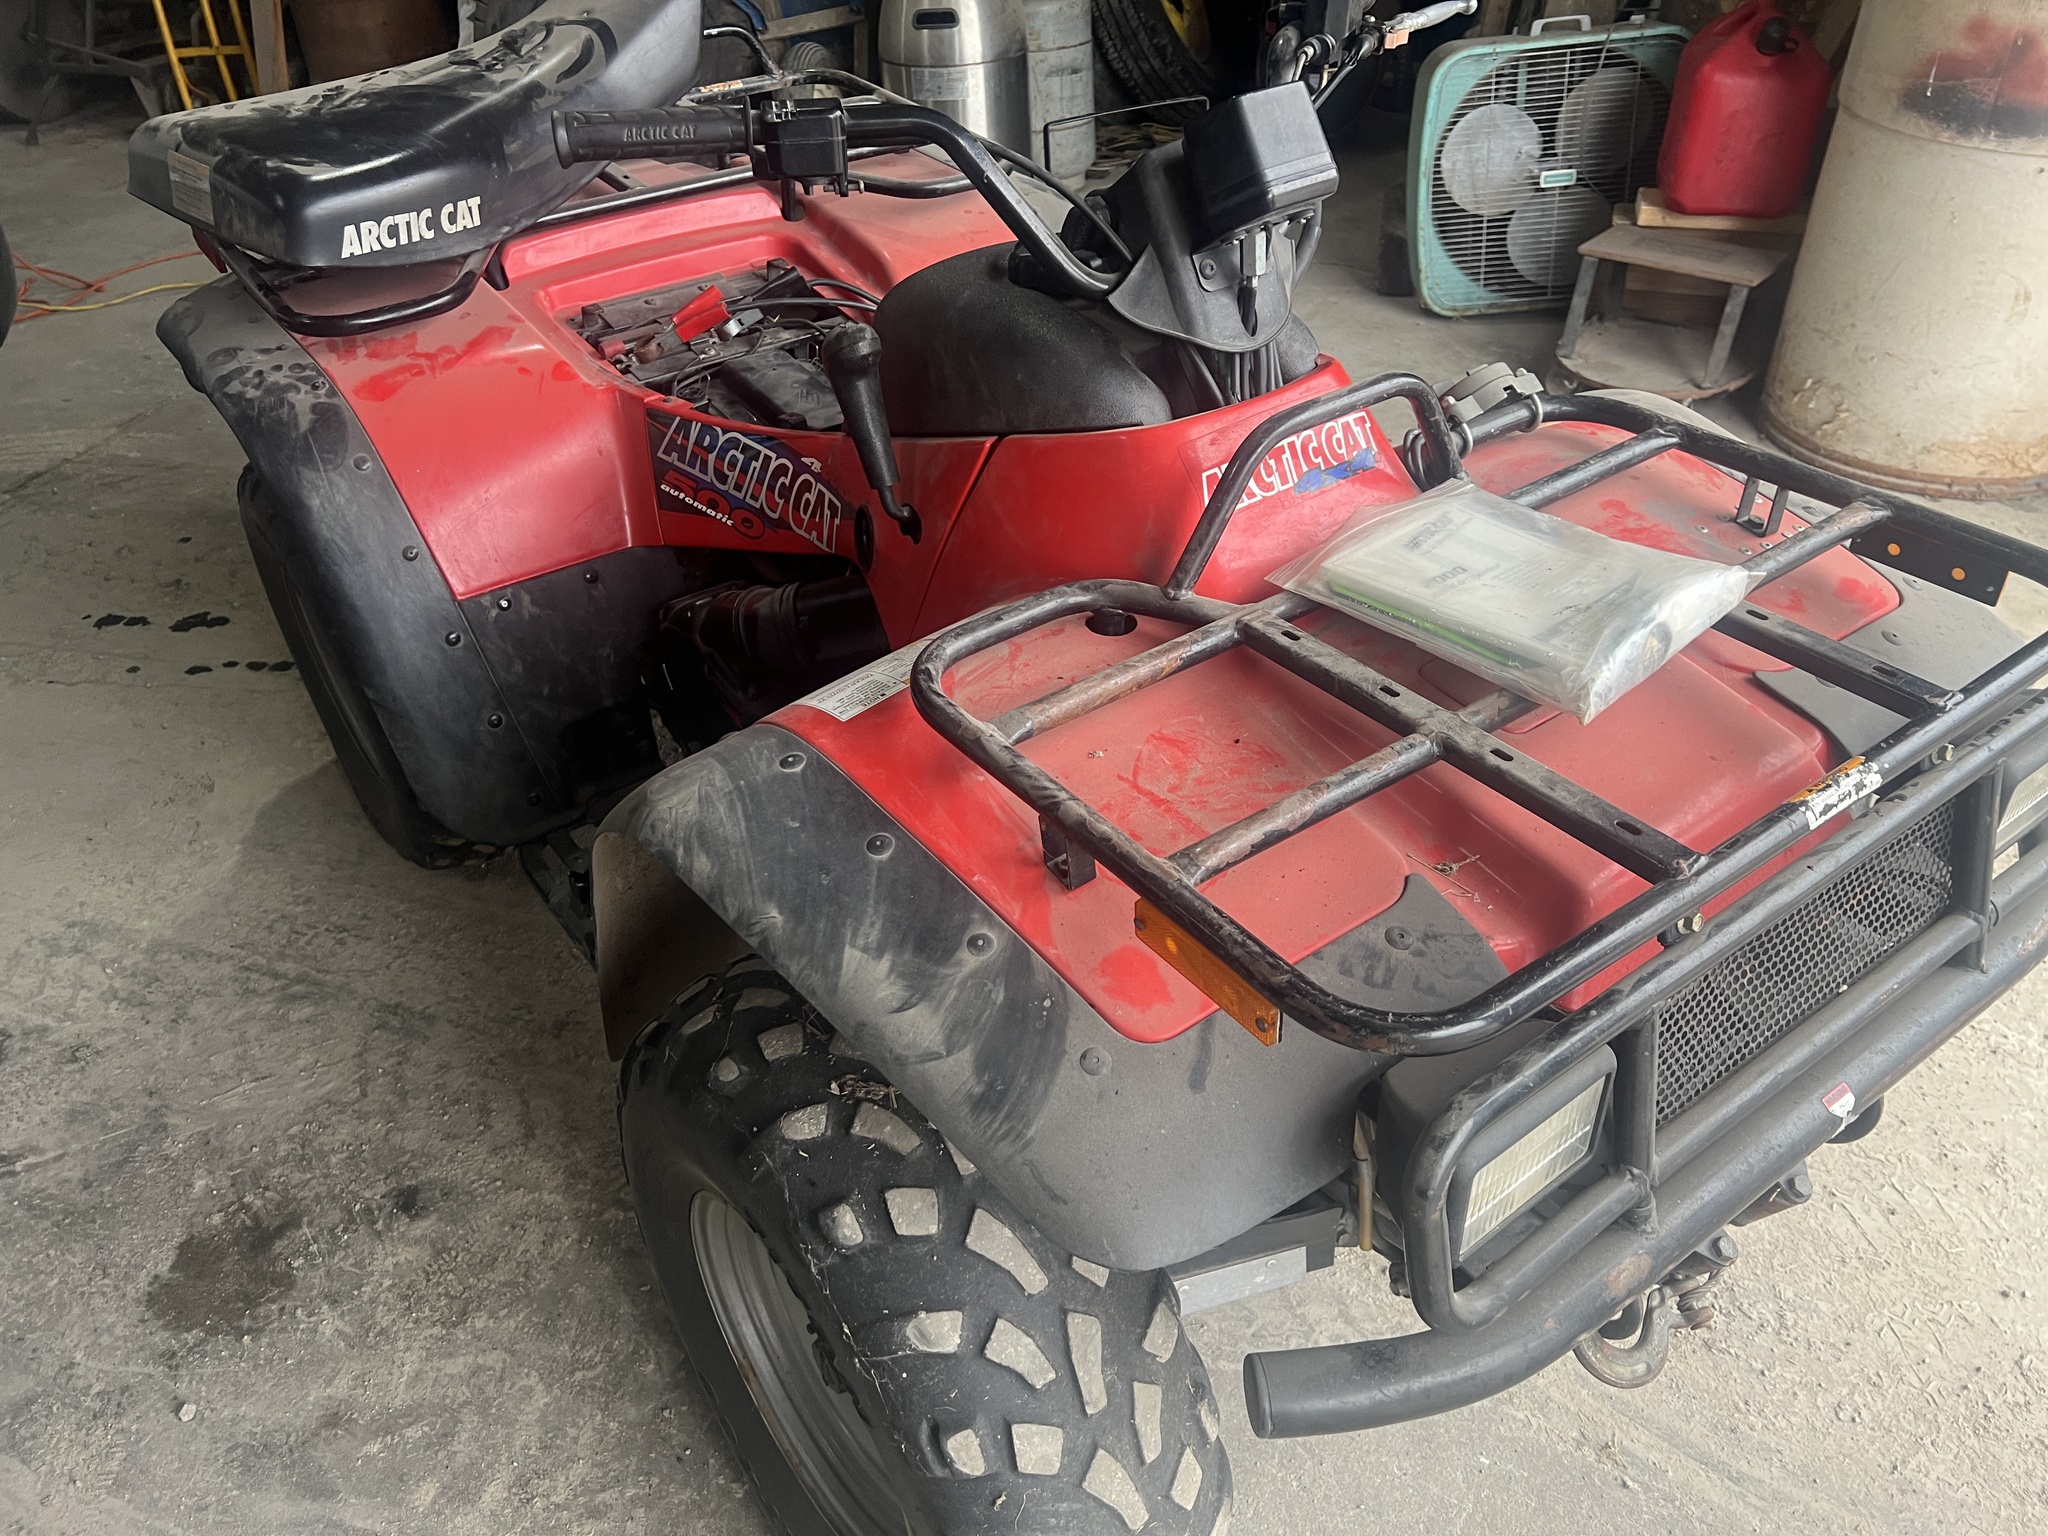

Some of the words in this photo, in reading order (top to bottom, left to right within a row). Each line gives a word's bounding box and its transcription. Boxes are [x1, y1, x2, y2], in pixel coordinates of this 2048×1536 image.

[623, 126, 668, 141] ARCTIC
[672, 124, 697, 138] CAT
[341, 208, 435, 259] ARCTIC
[440, 196, 481, 234] CAT
[1321, 411, 1378, 467] CAT
[657, 416, 794, 519] ARCTIC
[789, 474, 842, 554] CAT
[660, 483, 735, 527] automatic
[661, 469, 766, 540] 500
